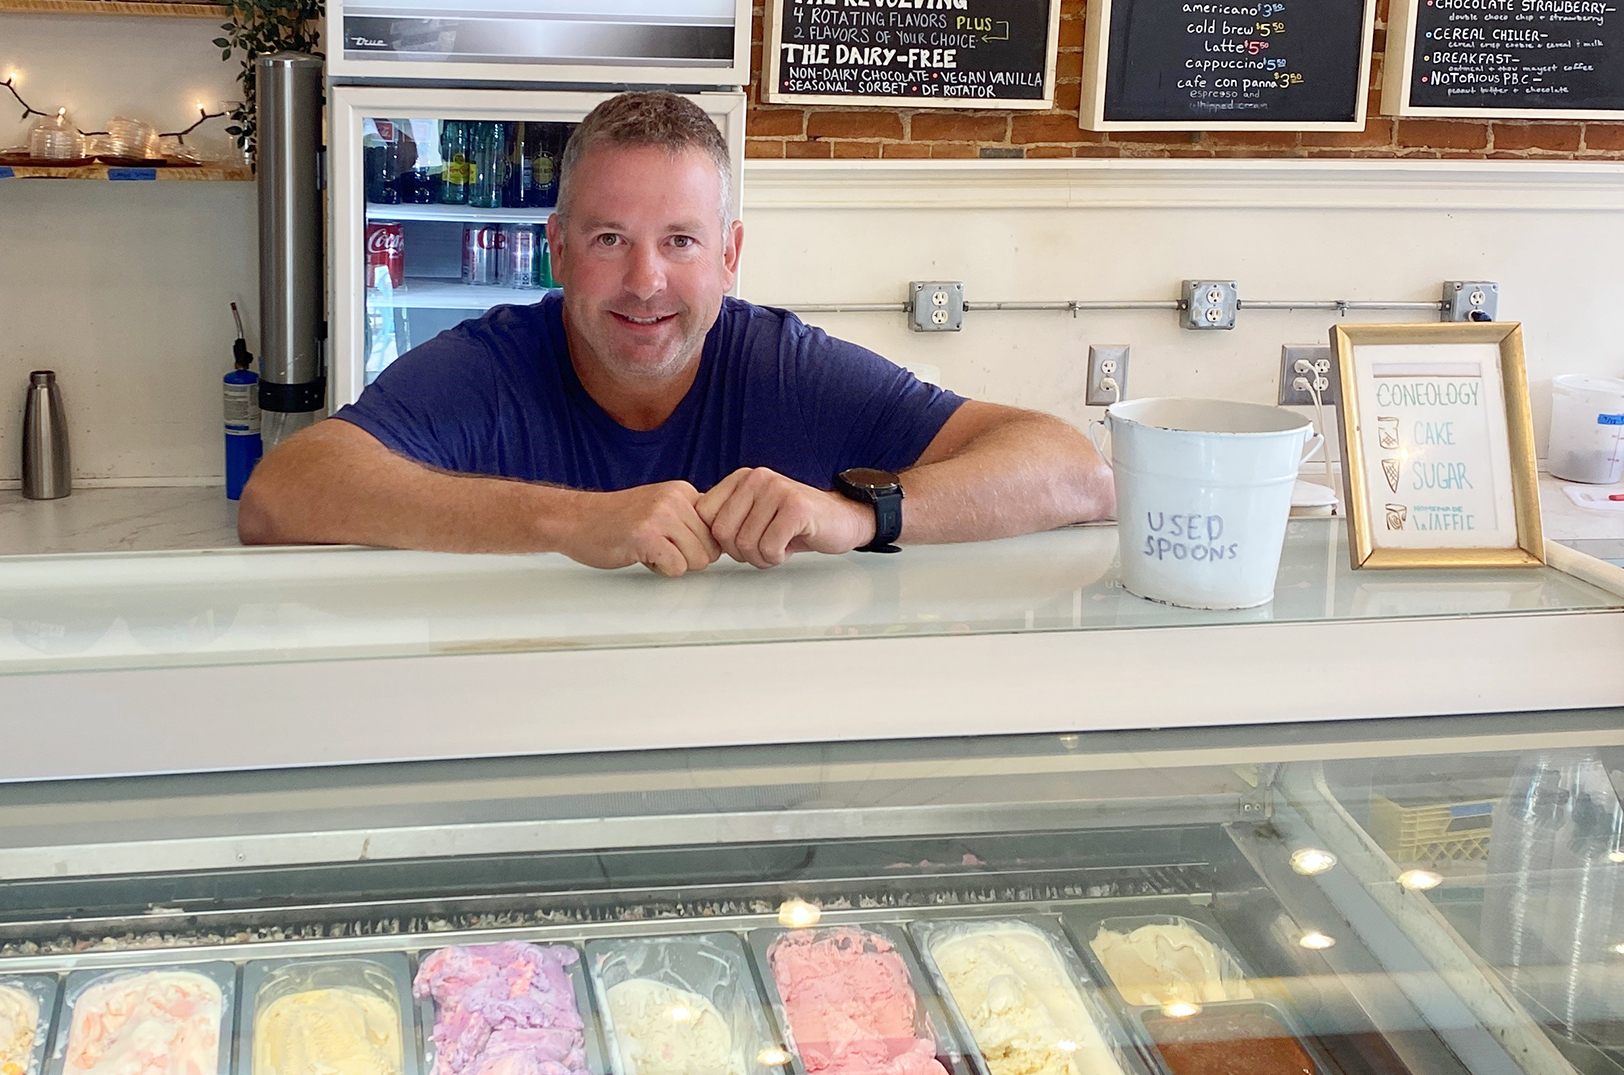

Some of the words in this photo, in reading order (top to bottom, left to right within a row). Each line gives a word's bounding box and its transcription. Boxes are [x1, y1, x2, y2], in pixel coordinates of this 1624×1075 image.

[1182, 2, 1258, 16] americano
[1435, 0, 1514, 11] CHOCOLATE
[793, 6, 804, 24] 4
[811, 7, 885, 26] ROTATING
[889, 11, 947, 29] FLAVORS
[956, 15, 992, 32] PLUS
[1186, 18, 1216, 34] cold
[1222, 20, 1254, 35] brew
[1448, 12, 1478, 21] double
[1483, 13, 1509, 21] choco
[1515, 13, 1534, 22] chip
[1549, 13, 1604, 26] strawberry
[793, 26, 805, 39] 2
[809, 25, 870, 44] FLAVORS
[875, 30, 891, 44] OF
[896, 30, 927, 46] YOUR
[1433, 27, 1485, 40] CEREAL
[1583, 39, 1604, 48] milk
[781, 42, 830, 65] THE
[835, 44, 957, 69] DAIRY-FREE
[1185, 57, 1264, 72] cappuccino
[1563, 62, 1595, 72] coffee
[789, 66, 858, 81] NON-DAIRY
[861, 69, 930, 83] CHOCOLATE
[940, 71, 986, 85] VEGAN
[989, 71, 1043, 88] VANILLA
[1177, 74, 1207, 88] cafe
[1214, 78, 1238, 88] con
[1242, 78, 1278, 92] panna
[1430, 70, 1501, 86] NOTORIOUS
[789, 79, 853, 93] SEASONAL
[858, 81, 908, 95] SORBET
[921, 84, 940, 96] DF
[943, 84, 997, 98] ROTATOR
[1189, 89, 1238, 99] espresso
[1243, 89, 1260, 98] and
[1447, 86, 1476, 96] peanut
[1525, 85, 1569, 94] chocolate
[1376, 382, 1479, 407] CONEOLOGY
[1413, 420, 1456, 446] CAKE
[1412, 461, 1474, 490] SUGAR
[1147, 511, 1224, 541] USED
[1143, 535, 1239, 562] SPOONS
